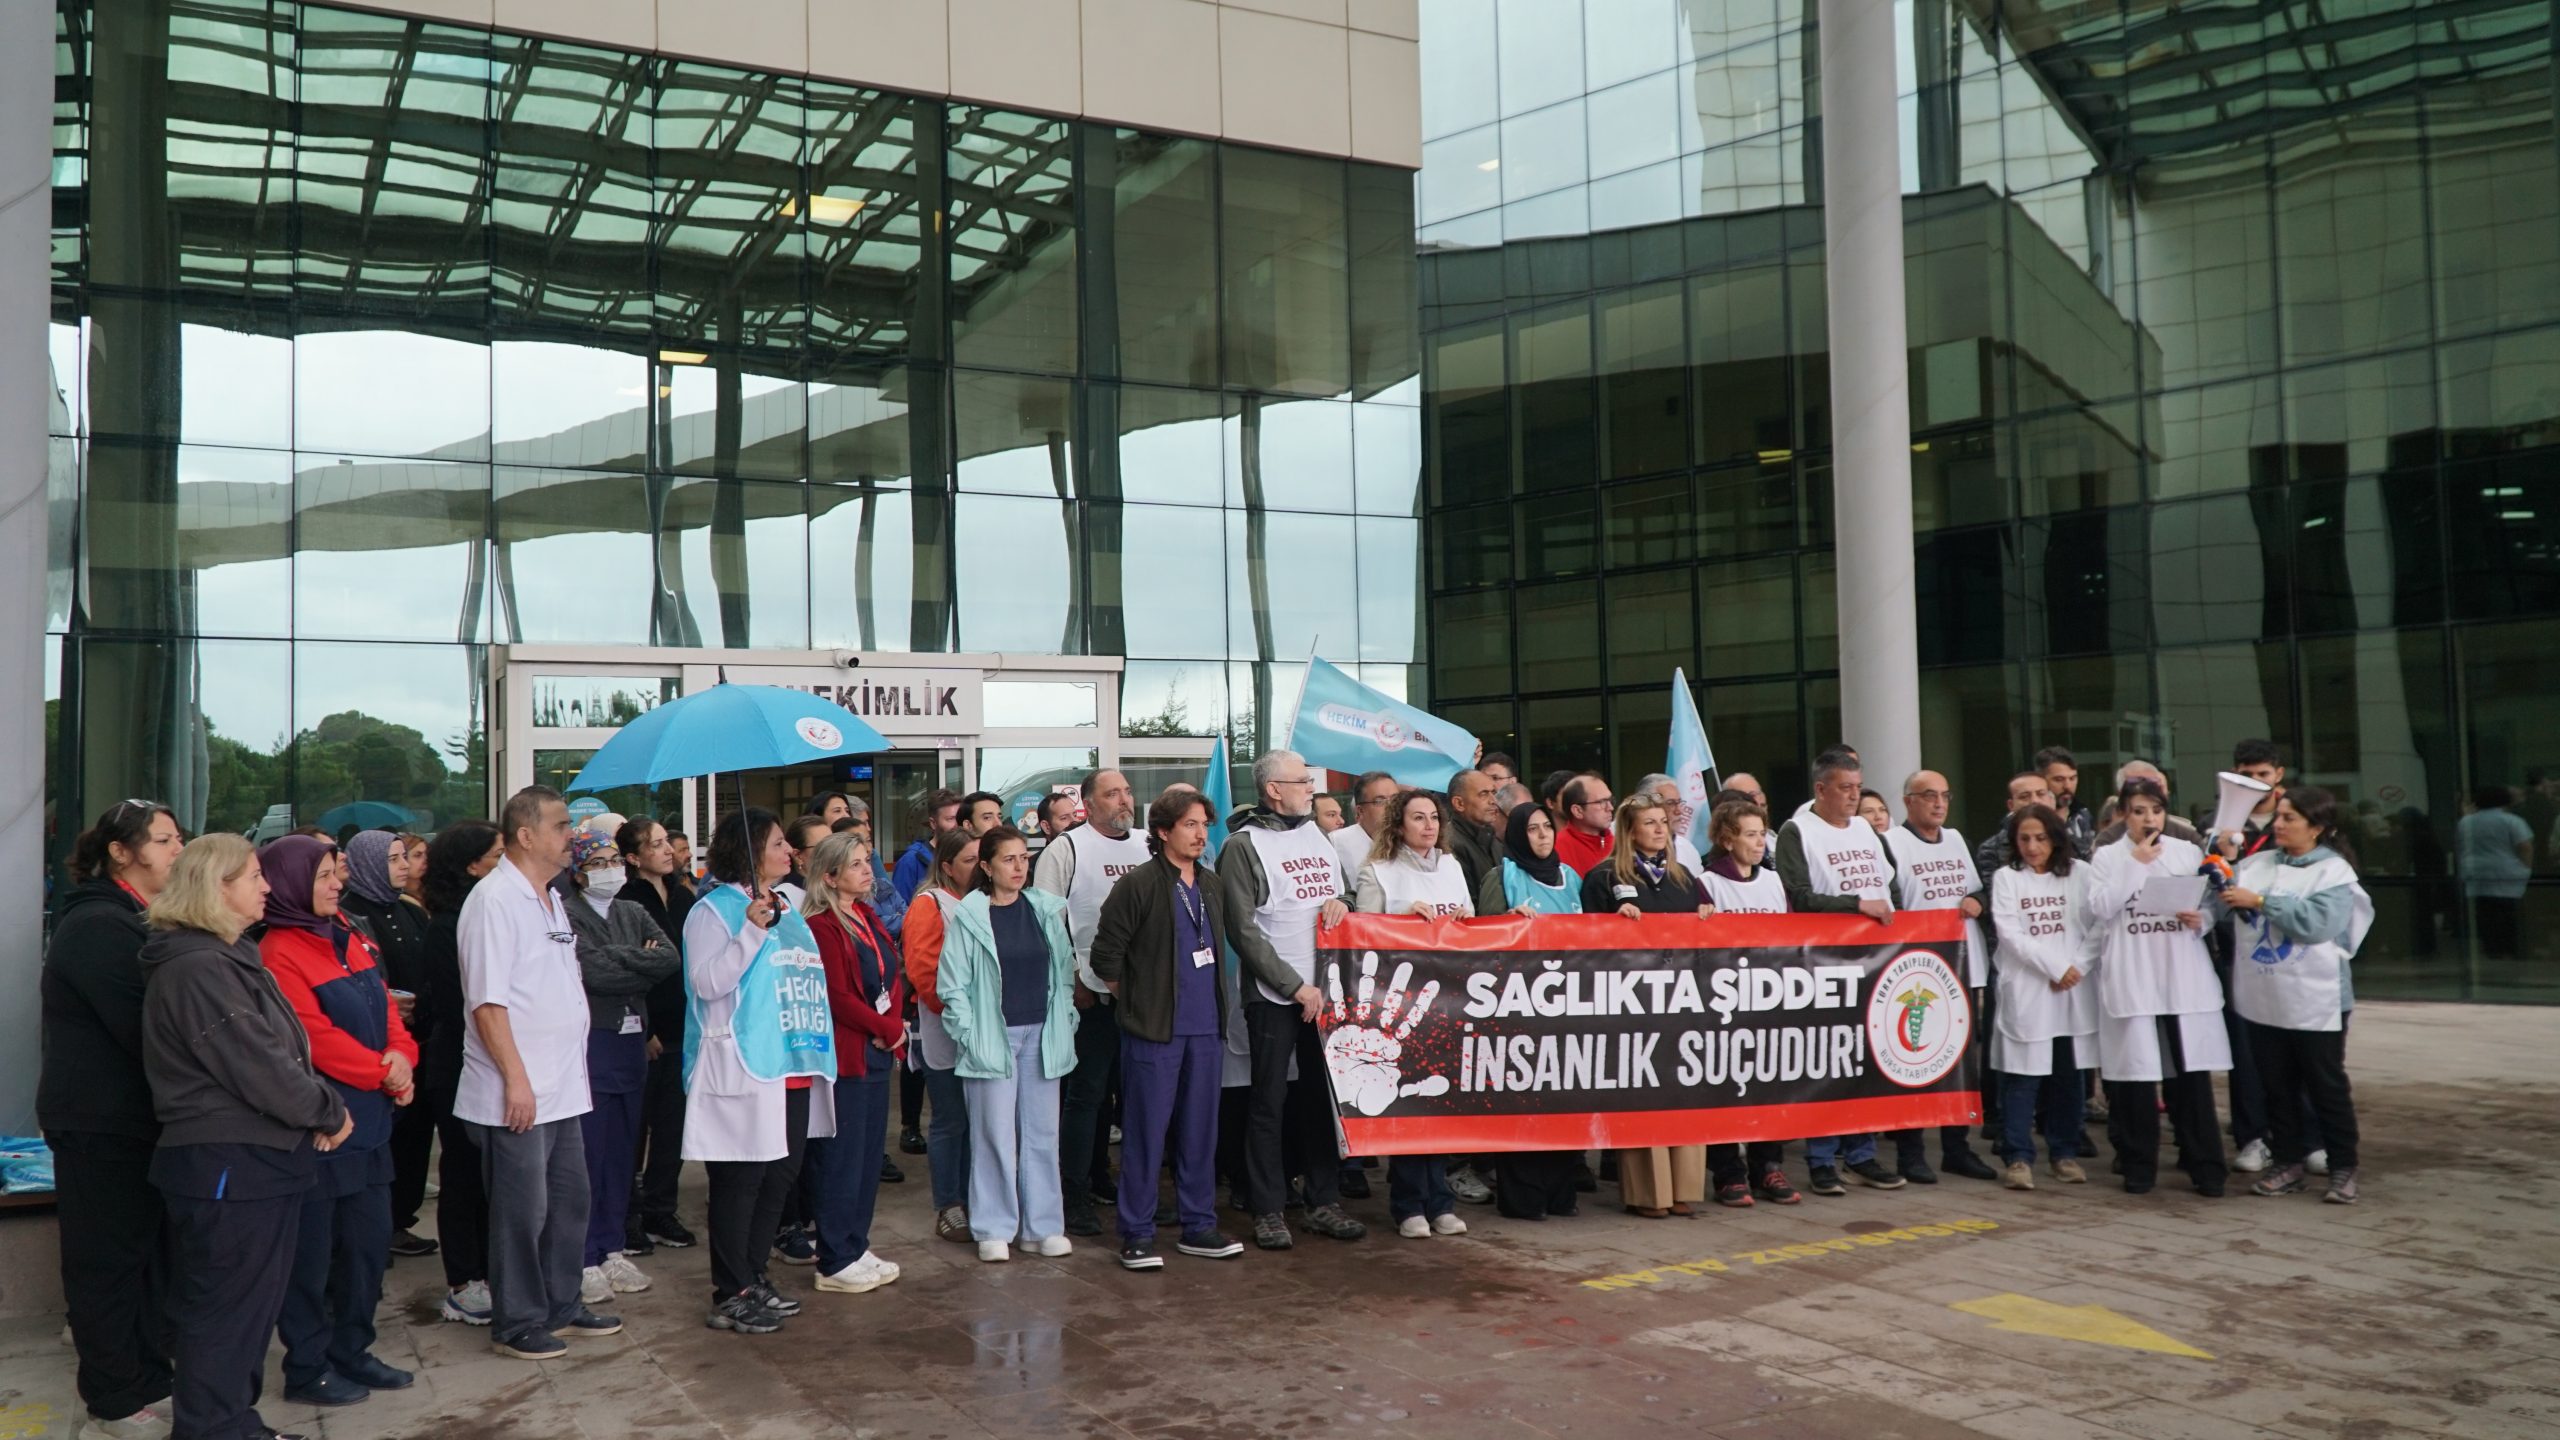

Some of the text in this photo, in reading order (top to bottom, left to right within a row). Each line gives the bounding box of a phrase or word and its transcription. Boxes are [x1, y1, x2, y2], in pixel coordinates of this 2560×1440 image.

[712, 679, 959, 716] KİMLİK
[1326, 710, 1367, 730] HEKİM
[1838, 862, 1879, 878] TABİ
[1912, 859, 1966, 876] BURSA
[1839, 876, 1884, 892] ODAS
[1922, 874, 1966, 888] TABİP
[1295, 885, 1335, 900] ODAS
[2020, 896, 2067, 910] BURS
[2027, 911, 2063, 922] TAB
[2029, 923, 2066, 936] ODA
[2127, 920, 2183, 935] ODASI
[774, 973, 829, 1004] HEKİM
[1462, 957, 1866, 1025] SAĞLIKTA ŞİDDET
[1460, 1022, 1866, 1098] İNSANLIK SUÇUDUR!
[1880, 1043, 1958, 1080] BURSA TABİP ODASI
[1579, 1257, 1730, 1292] ALAN
